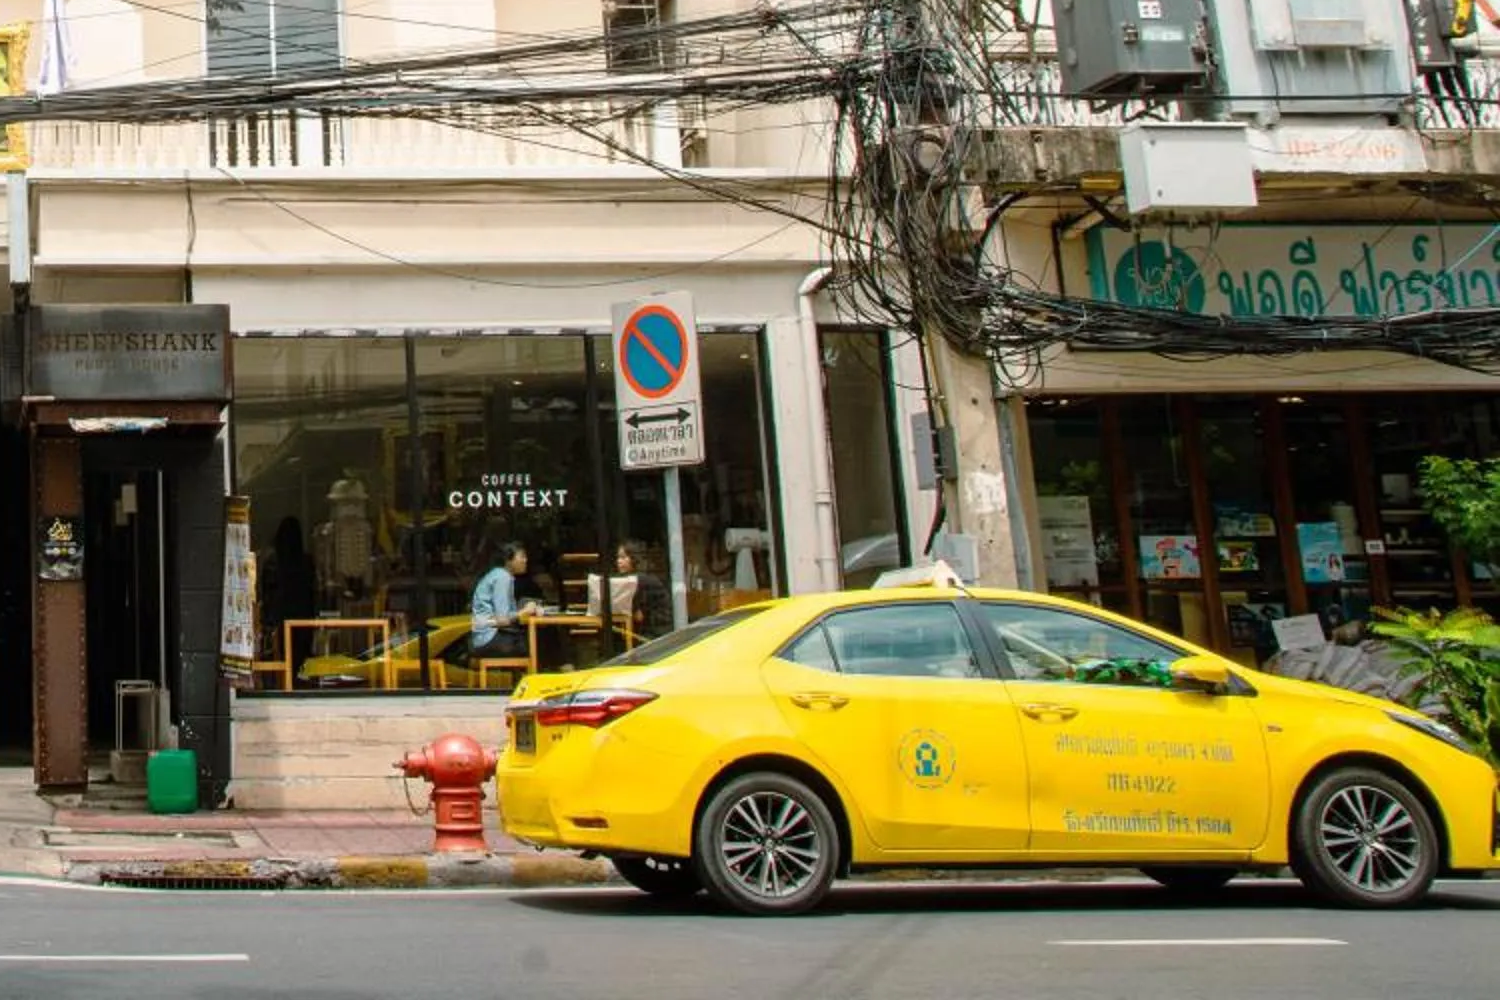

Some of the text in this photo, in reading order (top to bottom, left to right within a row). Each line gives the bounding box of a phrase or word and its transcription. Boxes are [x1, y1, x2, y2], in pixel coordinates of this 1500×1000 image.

[36, 332, 217, 352] SHEEPSHANK
[481, 473, 531, 487] COFFEE
[449, 489, 568, 508] CONTEXT
